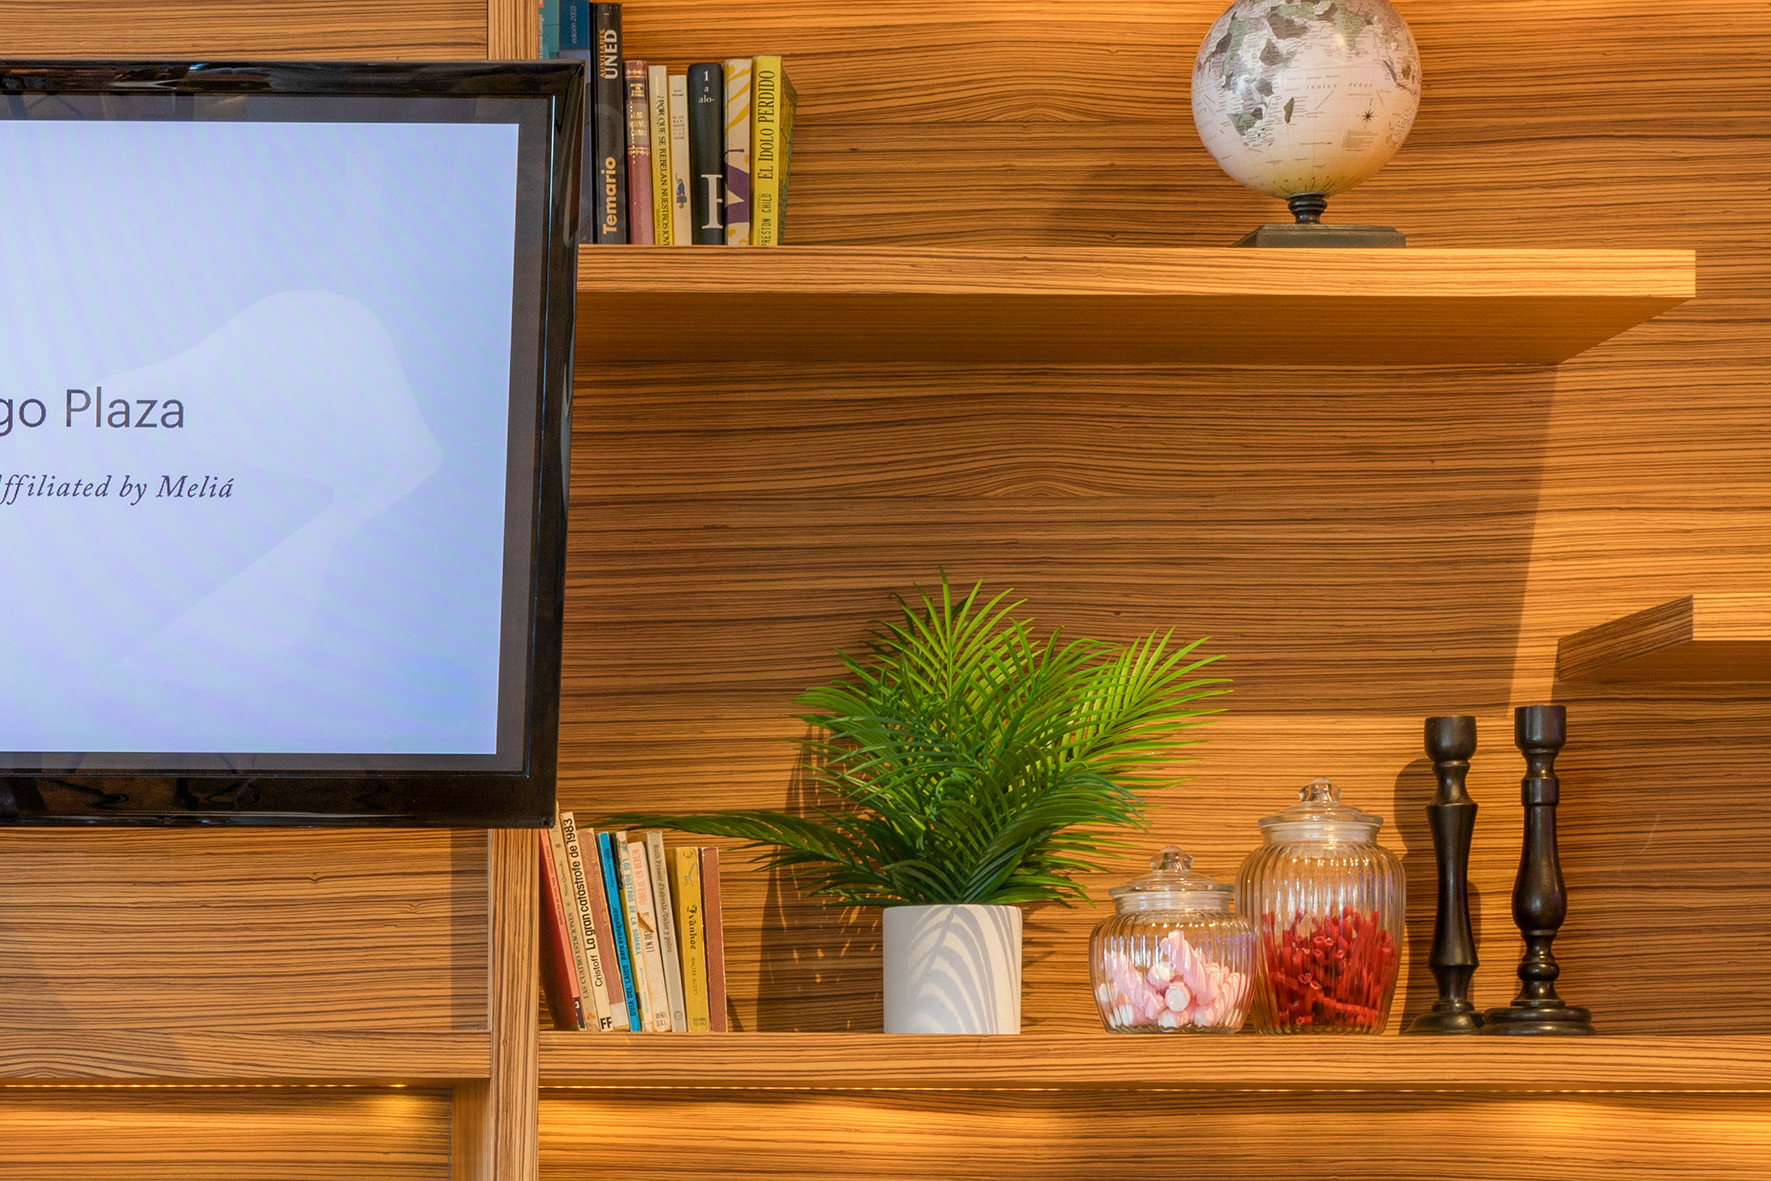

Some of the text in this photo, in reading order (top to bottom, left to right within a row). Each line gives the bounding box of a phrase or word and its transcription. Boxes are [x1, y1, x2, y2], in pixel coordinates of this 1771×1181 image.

[604, 29, 619, 80] UNED
[703, 71, 710, 81] 1
[657, 118, 666, 135] QUE
[659, 135, 666, 146] SE
[758, 70, 775, 180] EL IDOLO PERDIDO
[659, 148, 668, 186] REBELAN
[601, 156, 617, 234] Temario
[661, 188, 669, 229] NUESTROS
[761, 193, 773, 246] PRESTON CHILD
[66, 386, 185, 428] Plaza
[119, 474, 147, 506] by
[156, 475, 235, 499] Meliá
[563, 818, 576, 844] 1983
[569, 845, 578, 858] de
[622, 858, 631, 872] LOS
[629, 905, 637, 916] DE
[653, 844, 662, 859] Ruth
[664, 936, 673, 954] polvo
[581, 913, 596, 936] gran
[630, 917, 638, 926] LA
[567, 912, 589, 999] LAS CUATRO ESTACIONES
[586, 937, 596, 951] La
[594, 954, 603, 987] Cristoff
[612, 906, 637, 1017] GUIA DEL LAICO para evangelizar
[600, 1016, 613, 1030] FF
